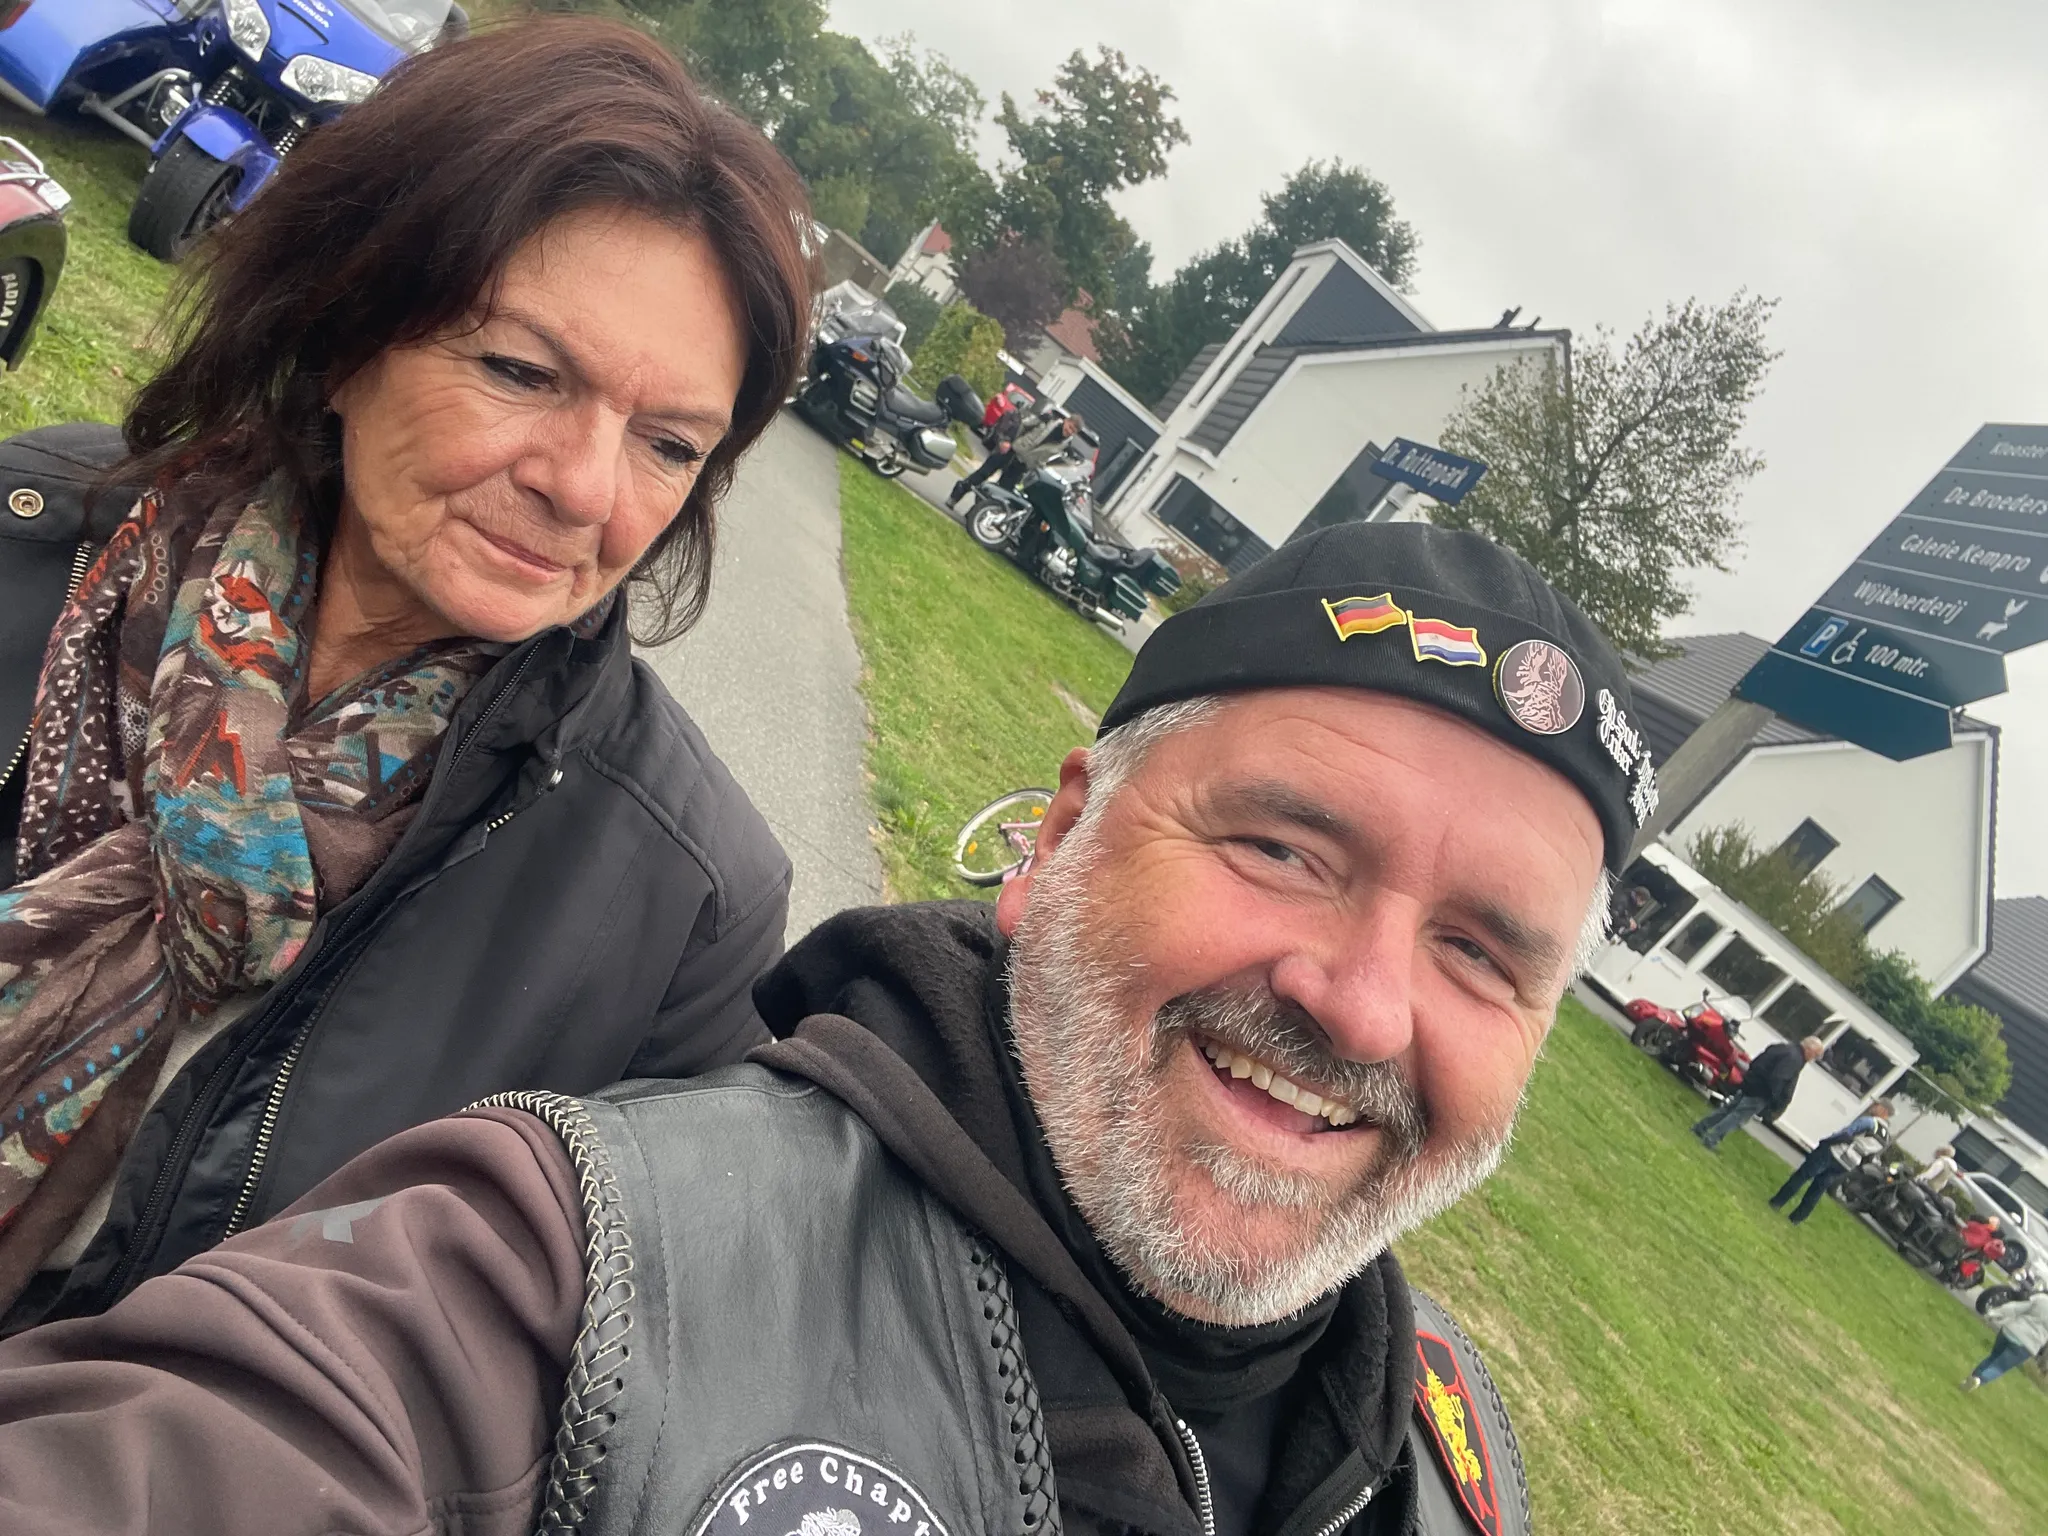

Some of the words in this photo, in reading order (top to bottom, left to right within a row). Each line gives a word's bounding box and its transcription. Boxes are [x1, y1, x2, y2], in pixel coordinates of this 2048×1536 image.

[1943, 486, 1970, 505] De
[1968, 489, 2048, 515] Broeders
[1900, 533, 1960, 559] Galerie
[1958, 543, 2031, 573] Kempro
[1853, 580, 1968, 625] Wijkboerderij
[1811, 623, 1838, 649] P
[1864, 644, 1899, 668] 100
[1893, 655, 1929, 678] mtr.
[729, 1461, 804, 1526] Free
